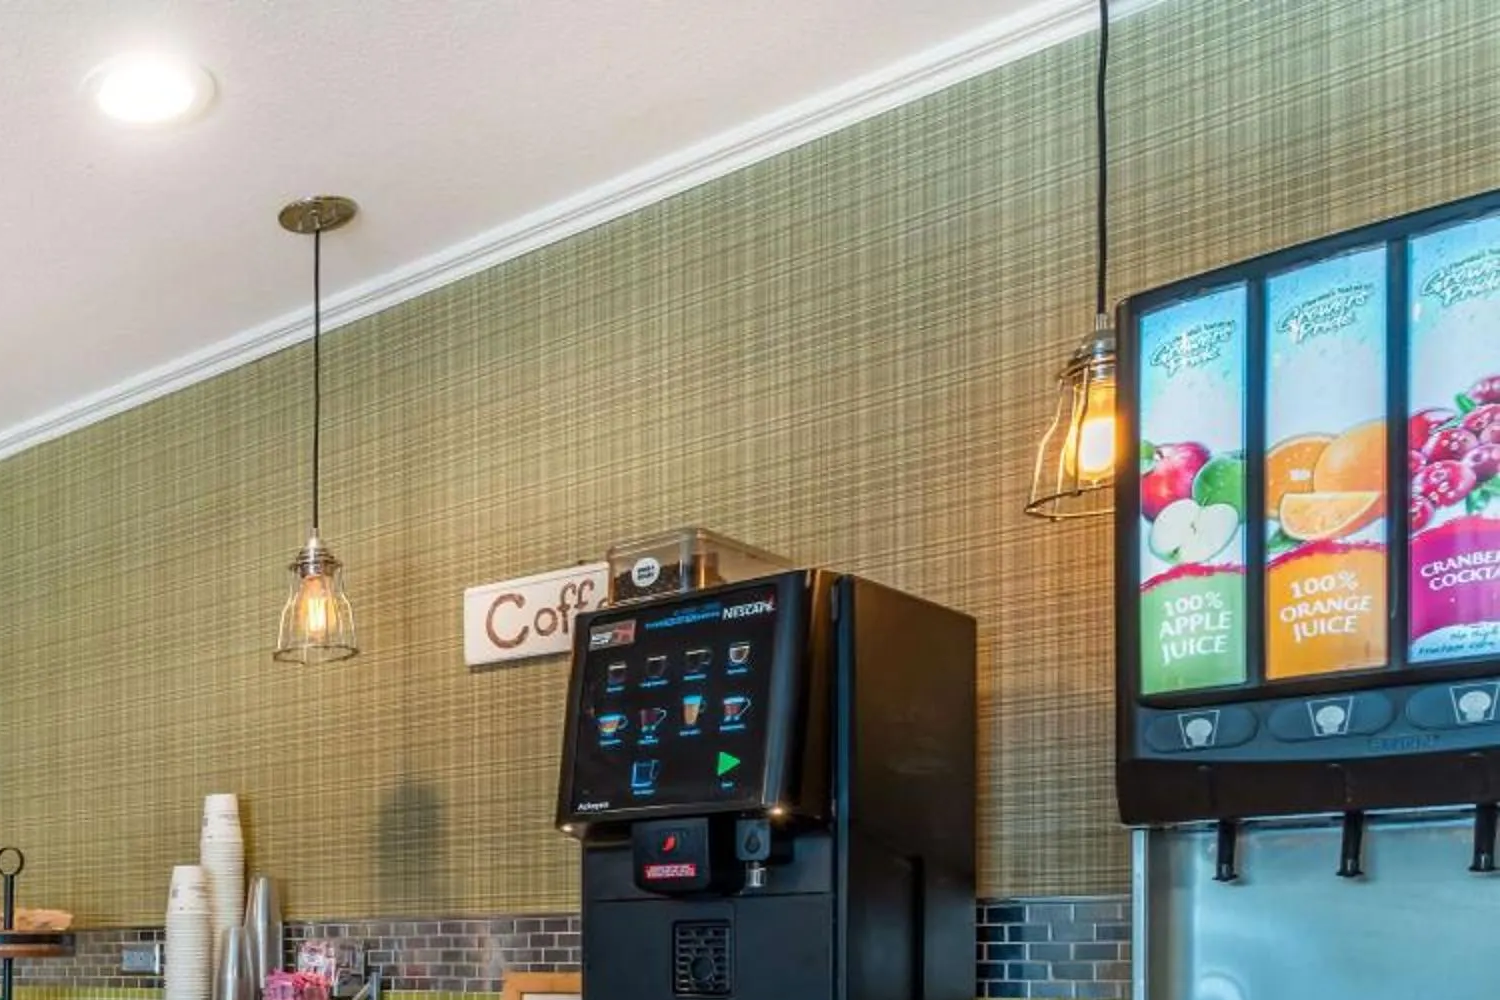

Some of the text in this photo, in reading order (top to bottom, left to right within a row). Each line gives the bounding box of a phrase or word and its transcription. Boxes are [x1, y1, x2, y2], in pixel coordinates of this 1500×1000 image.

[1290, 570, 1359, 599] 100%
[485, 579, 609, 649] Coff
[1164, 591, 1224, 618] 100%
[1279, 594, 1372, 624] ORANGE
[1159, 610, 1233, 640] APPLE
[1292, 615, 1358, 643] JUICE
[1160, 634, 1229, 666] JUICE
